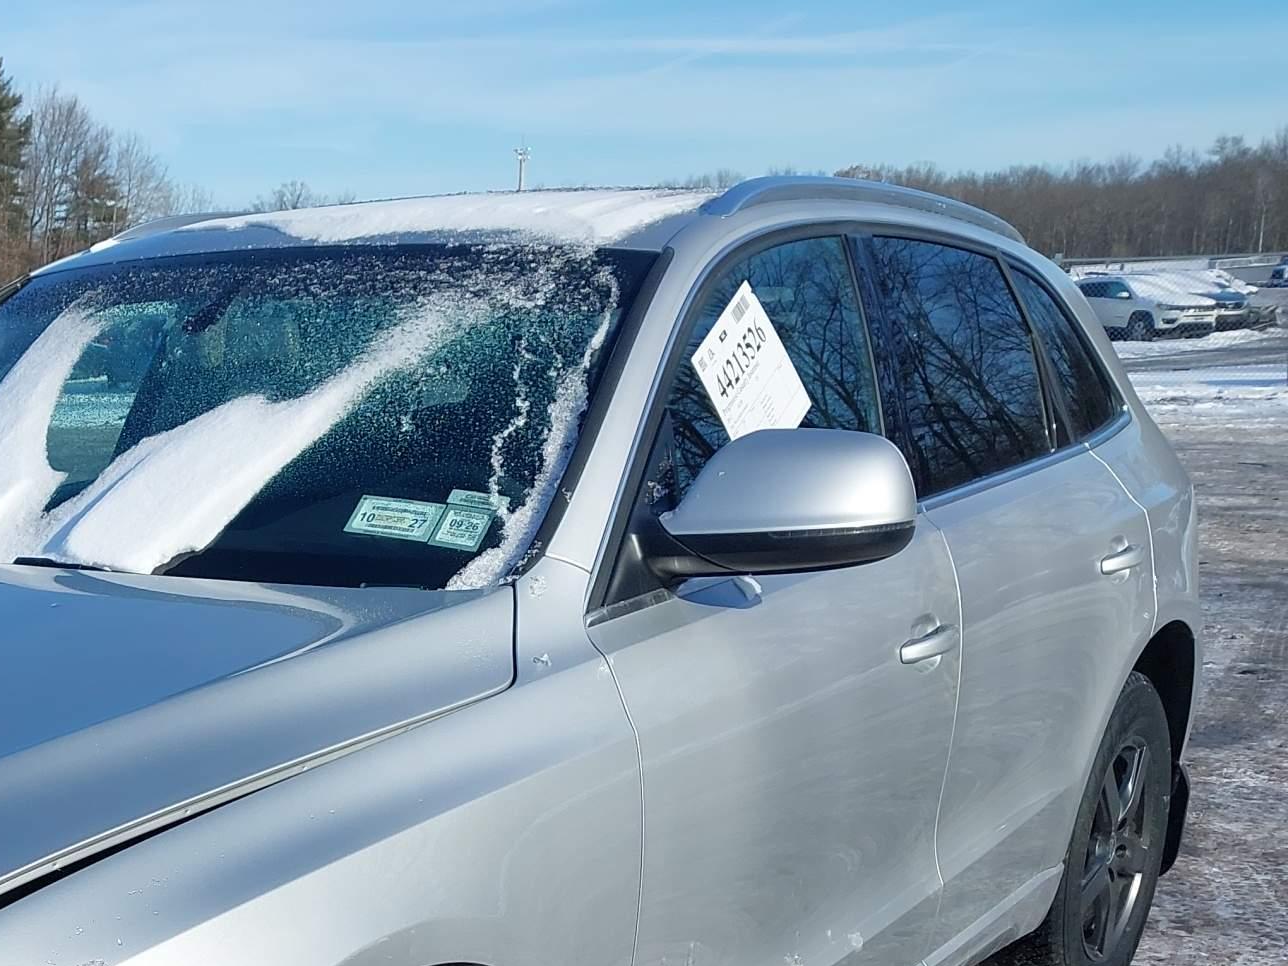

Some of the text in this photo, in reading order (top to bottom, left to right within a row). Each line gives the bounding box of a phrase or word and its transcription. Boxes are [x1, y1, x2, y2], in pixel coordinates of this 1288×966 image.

[716, 317, 767, 399] 44213526
[360, 511, 375, 523] 10
[408, 518, 427, 529] 27
